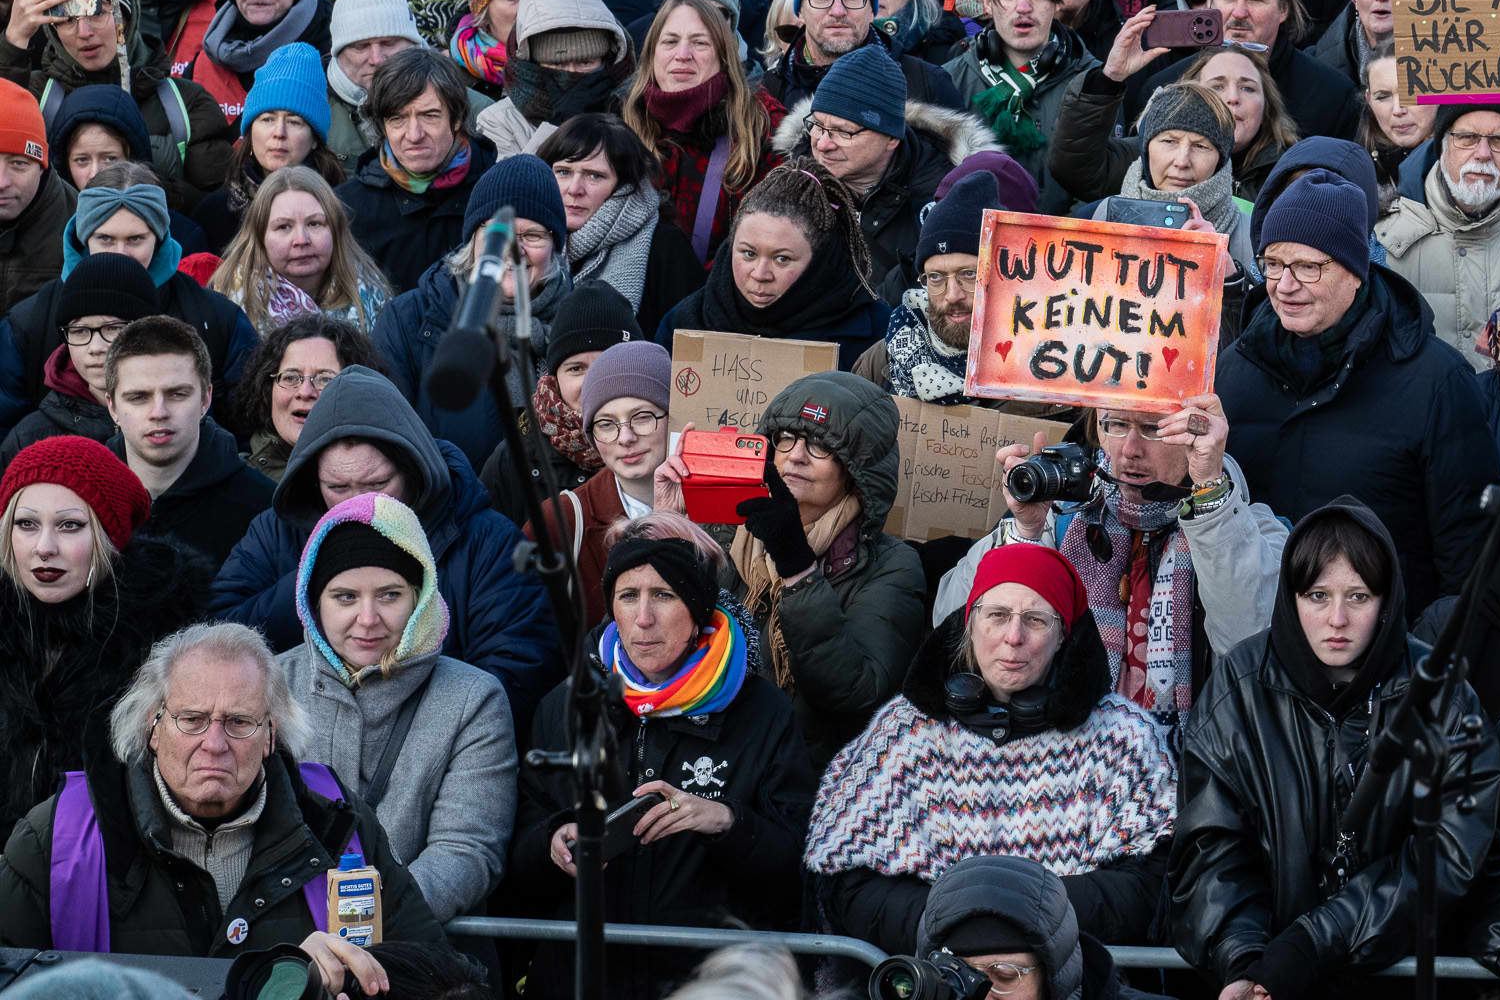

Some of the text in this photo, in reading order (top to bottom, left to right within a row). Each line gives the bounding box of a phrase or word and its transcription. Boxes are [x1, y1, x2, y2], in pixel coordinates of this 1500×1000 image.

[1411, 16, 1491, 55] WÄR
[996, 237, 1199, 301] WUT TUT
[711, 352, 763, 382] HASS
[1029, 339, 1152, 390] GUT!
[736, 387, 768, 406] UND
[925, 438, 980, 459] Faschos
[912, 482, 990, 510] fischt Fritze
